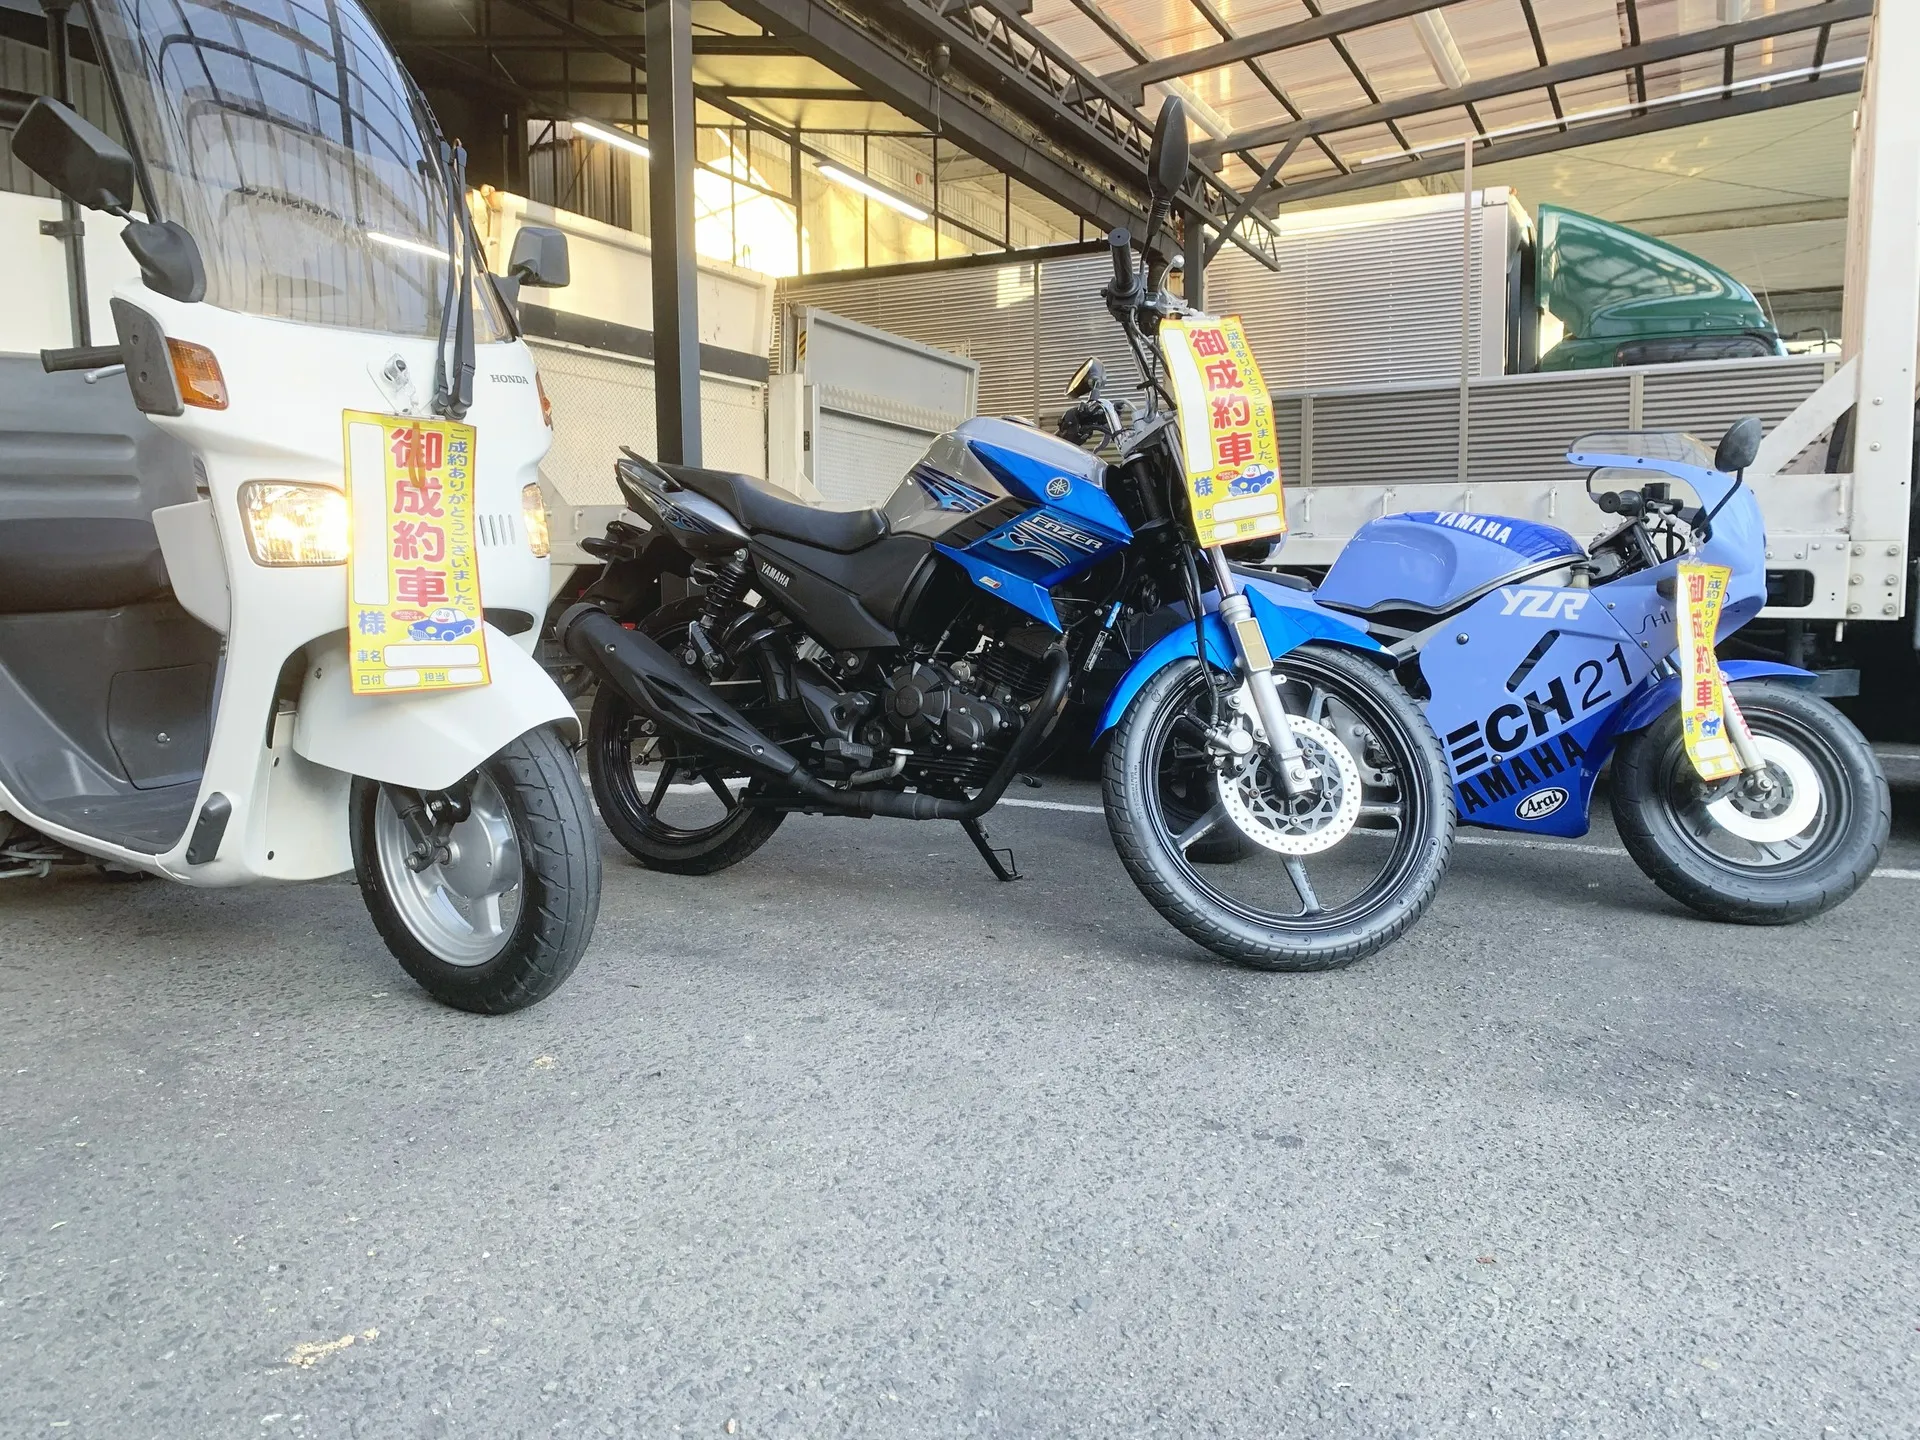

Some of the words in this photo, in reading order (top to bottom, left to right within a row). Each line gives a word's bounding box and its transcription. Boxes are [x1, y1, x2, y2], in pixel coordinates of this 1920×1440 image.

[490, 374, 529, 384] HONDA
[1189, 329, 1255, 467] 御成約車
[1194, 476, 1213, 497] 様
[390, 428, 449, 608] 御成約車
[1434, 512, 1512, 544] YAMAHA
[1032, 516, 1103, 549] FAZER
[761, 562, 790, 587] YAMAHA
[1500, 587, 1589, 620] YZR
[358, 610, 387, 636] 様
[1635, 611, 1675, 635] SHI
[357, 649, 382, 662] 車名
[360, 674, 381, 685] 日付
[424, 672, 446, 682] 担当
[1439, 676, 1575, 776] ECH
[1457, 731, 1587, 819] AMAHA
[1521, 790, 1561, 817] Arai
